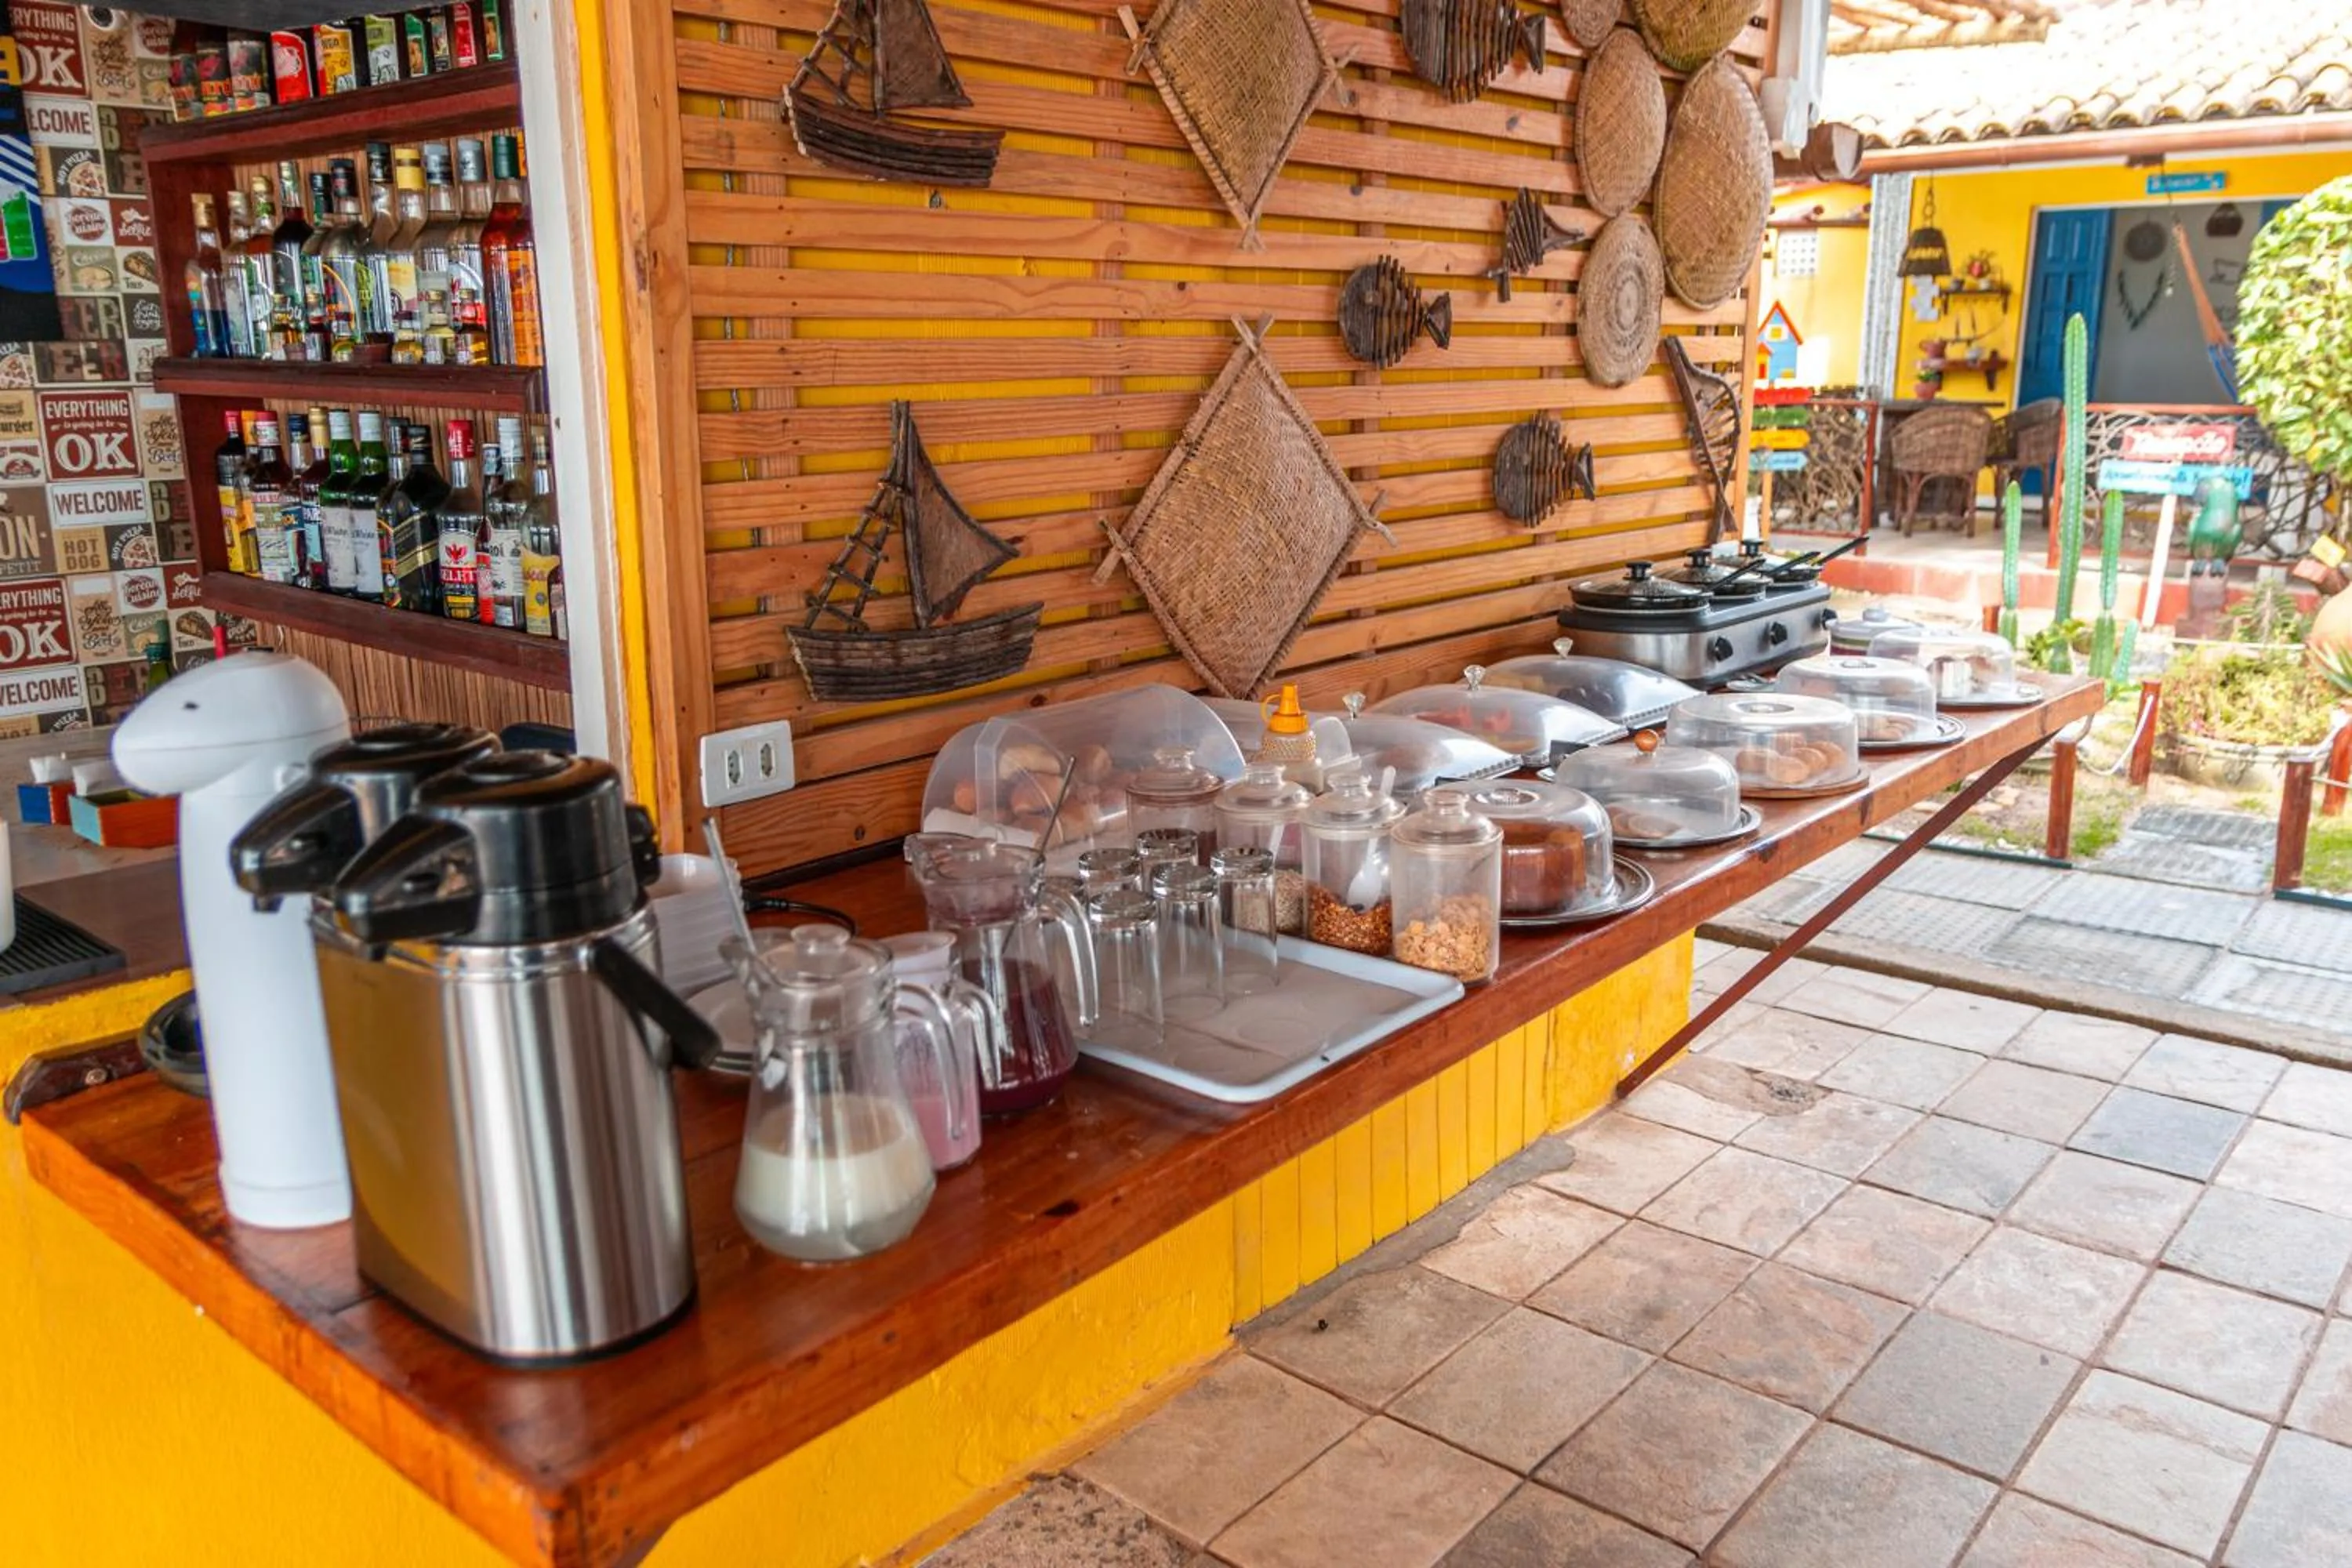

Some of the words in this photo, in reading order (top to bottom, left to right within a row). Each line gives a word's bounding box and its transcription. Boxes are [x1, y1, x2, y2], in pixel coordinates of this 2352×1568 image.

[45, 399, 129, 419] EVERYTHING
[54, 432, 135, 471] OK
[55, 488, 143, 516] WELCOME
[119, 524, 145, 542] PIZZA
[64, 538, 99, 554] HOT
[66, 554, 101, 571] DOG
[0, 620, 70, 663] OK
